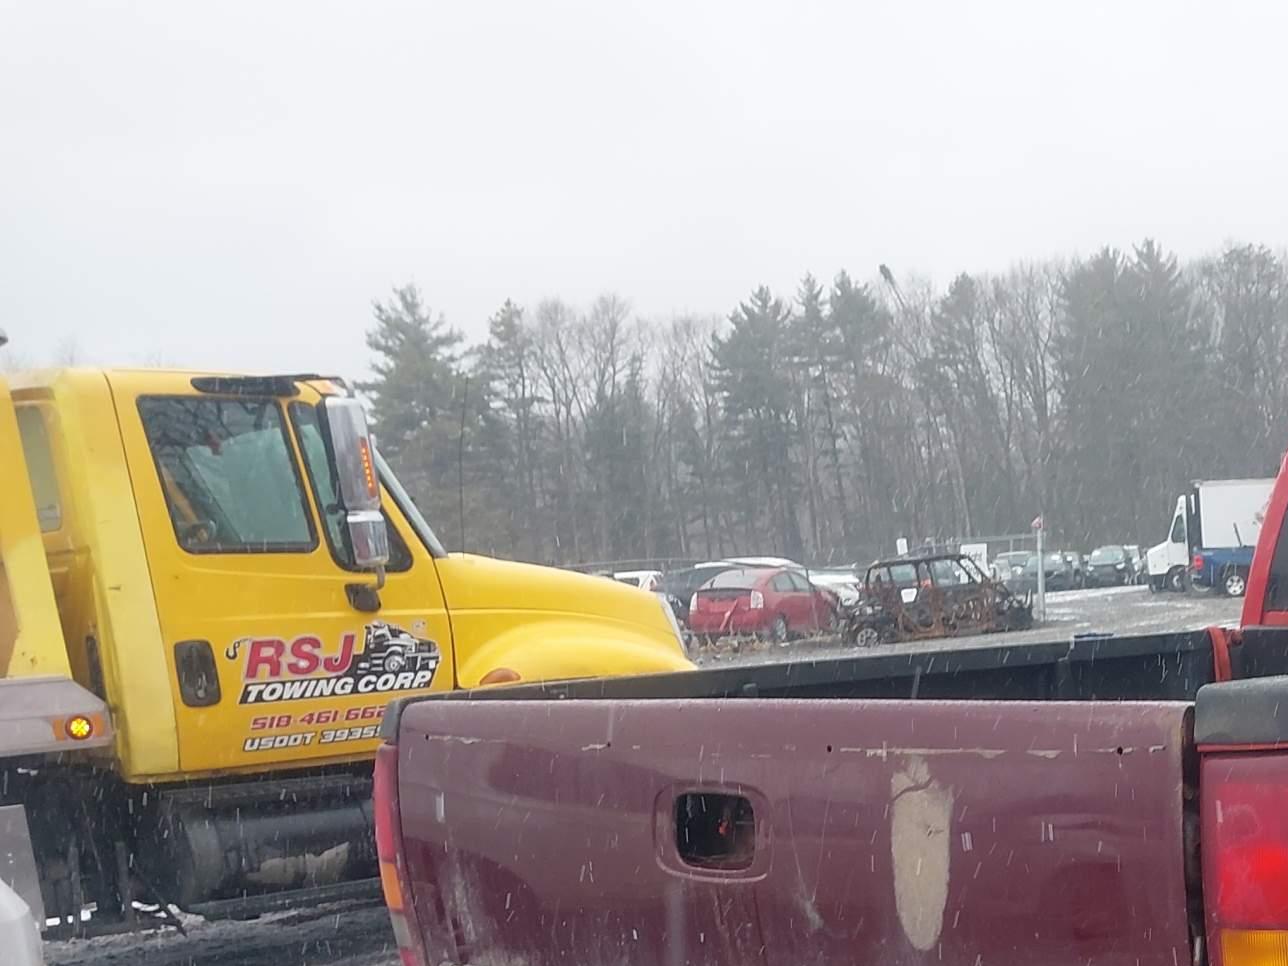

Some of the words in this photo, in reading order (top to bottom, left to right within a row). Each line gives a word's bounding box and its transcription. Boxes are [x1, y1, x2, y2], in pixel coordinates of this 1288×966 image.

[246, 634, 355, 679] RSJ
[246, 677, 352, 704] TOWING
[251, 714, 292, 731] 518
[300, 710, 339, 727] 461
[244, 731, 317, 752] USDOT
